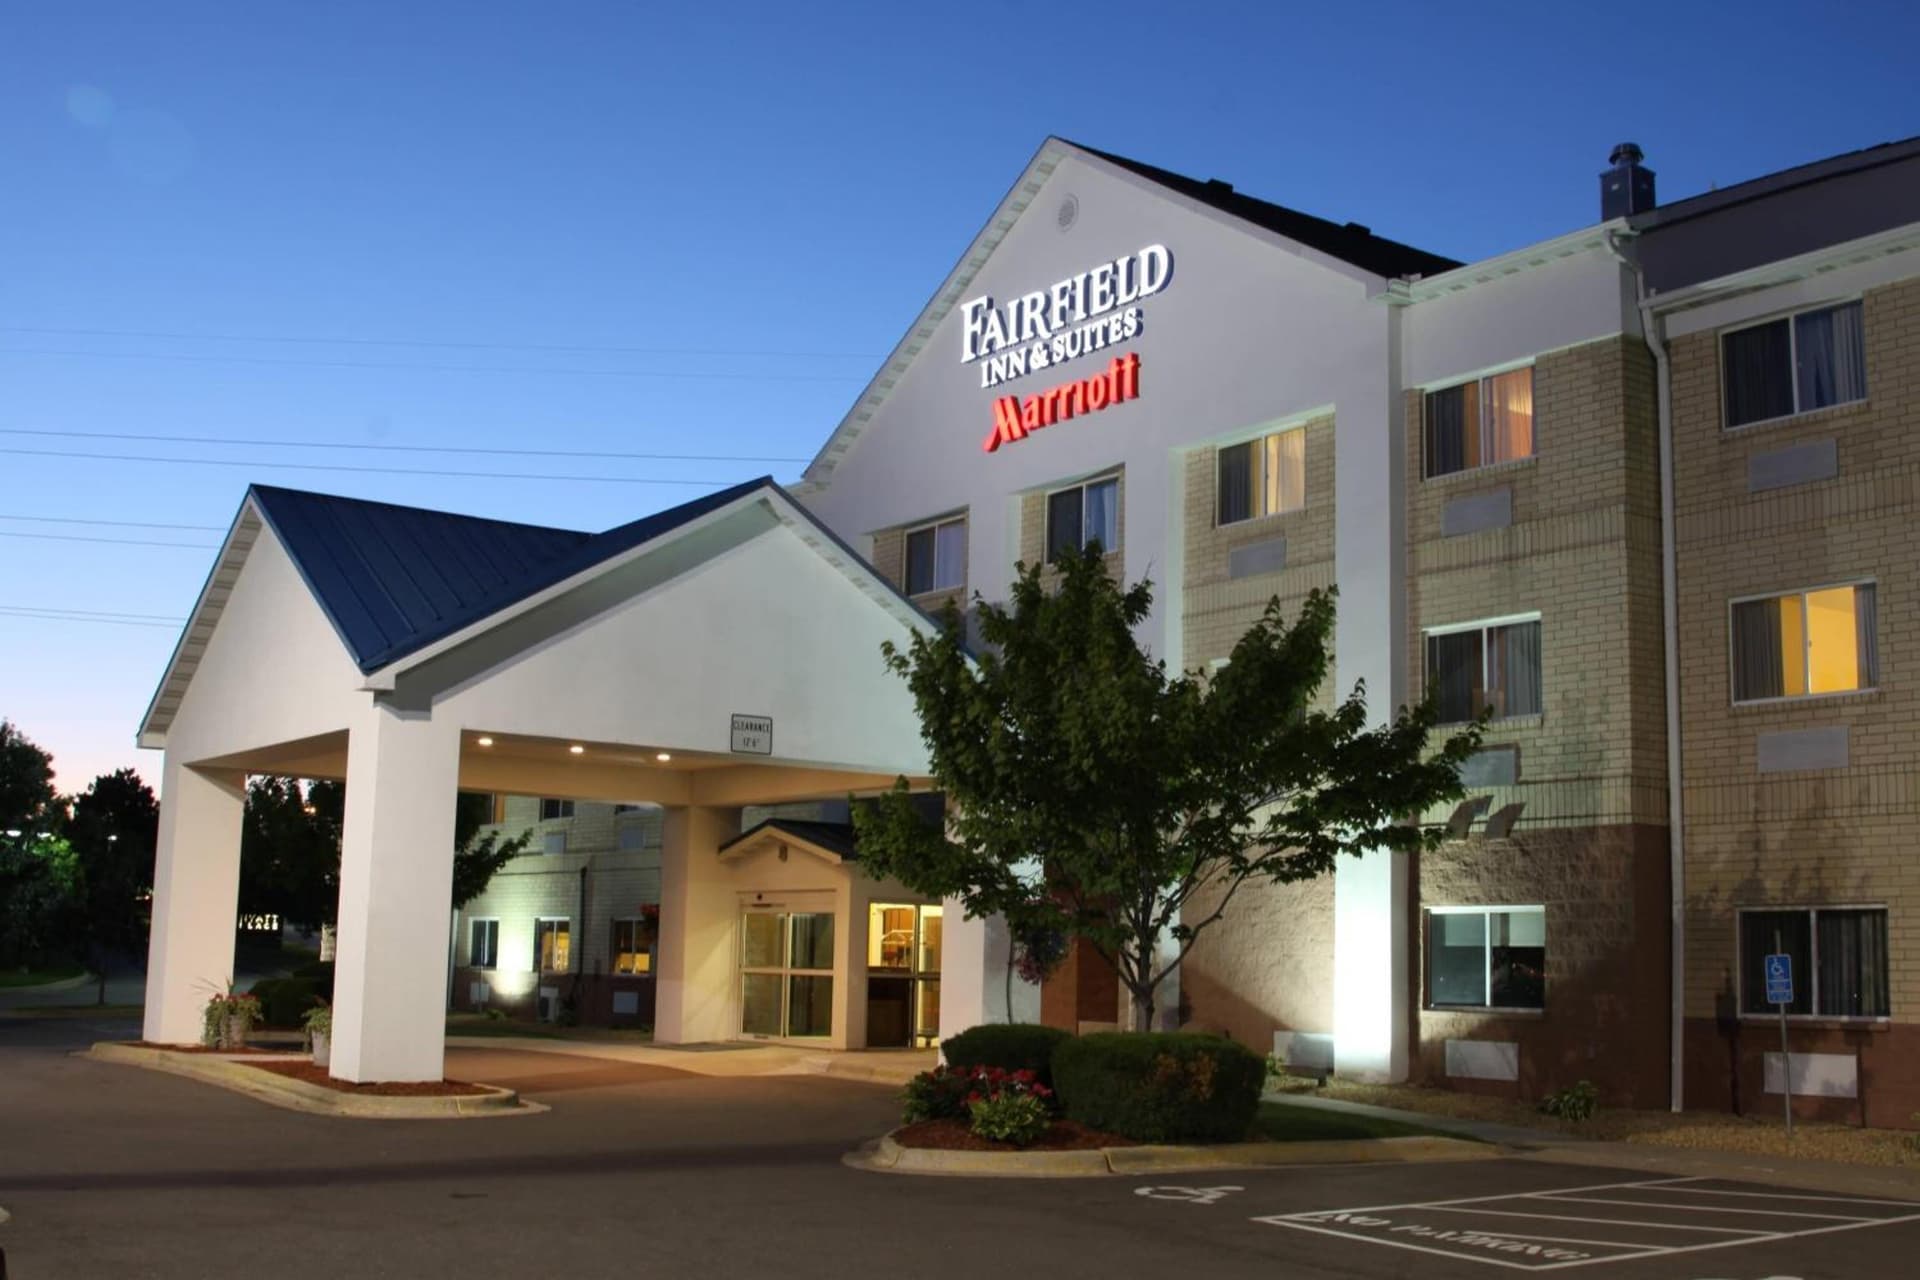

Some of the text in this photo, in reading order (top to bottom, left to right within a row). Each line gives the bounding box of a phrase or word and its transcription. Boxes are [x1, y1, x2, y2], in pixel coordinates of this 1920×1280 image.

[960, 243, 1173, 363] FAIRFIELD
[981, 348, 1028, 388] INN
[1052, 307, 1143, 364] SUITES
[983, 352, 1141, 452] Marriott
